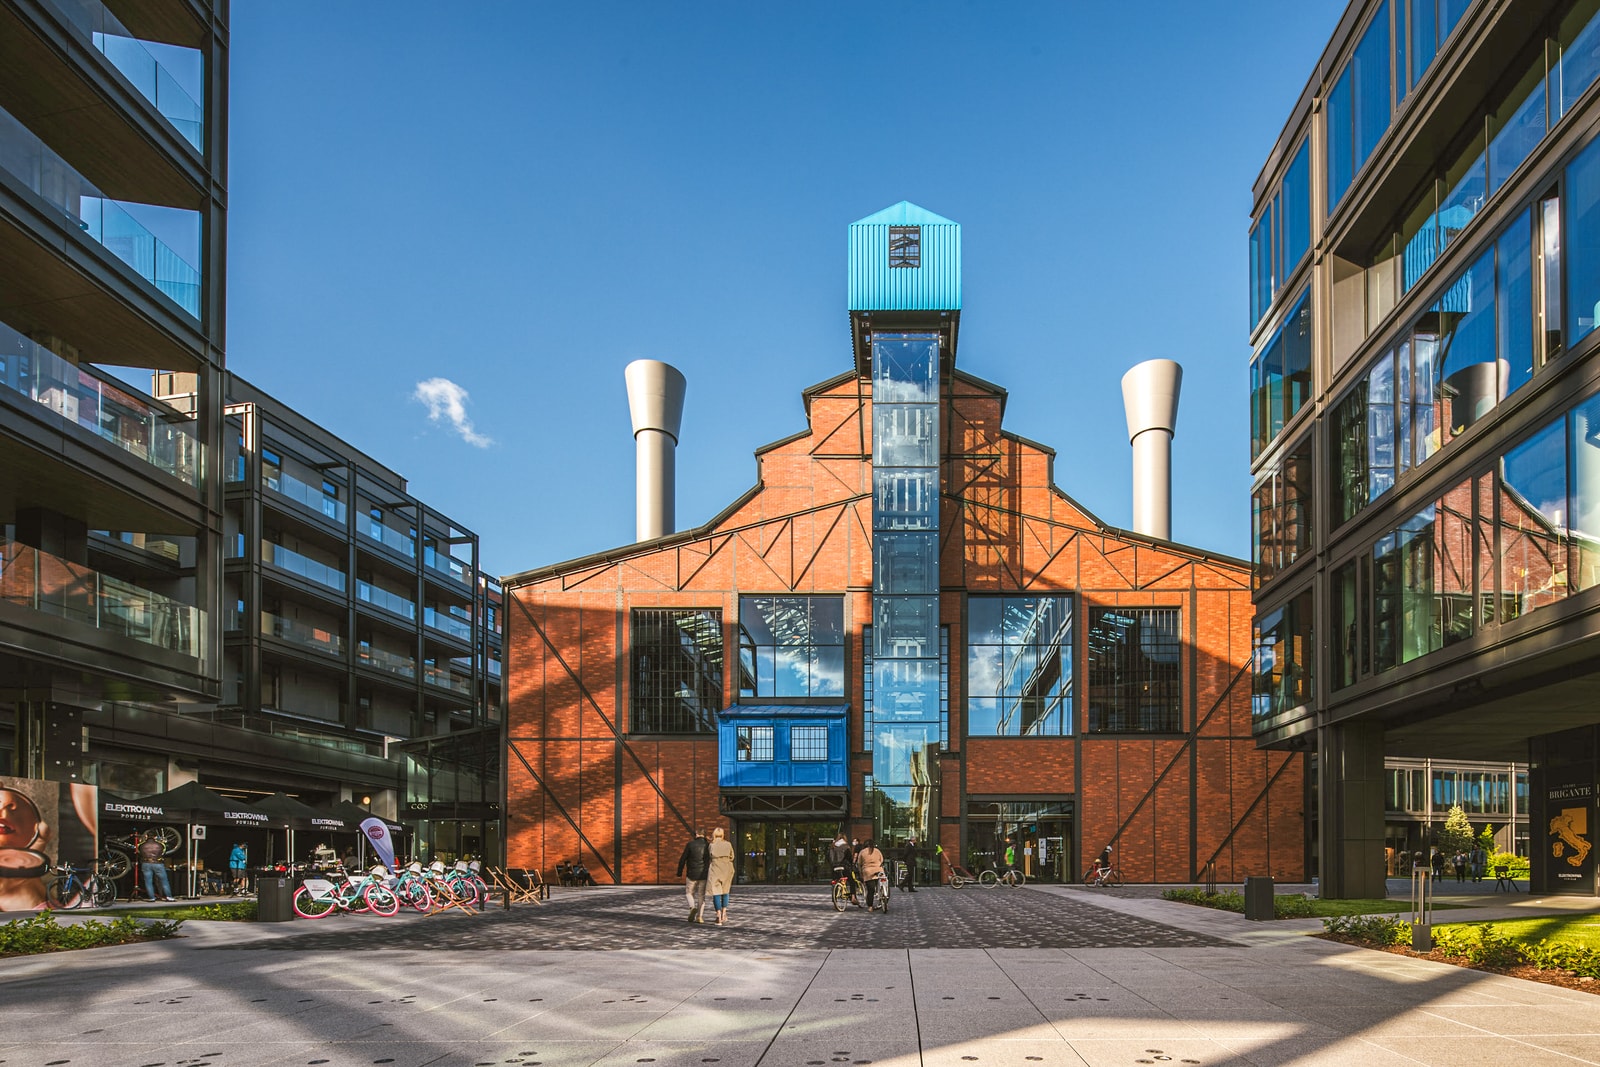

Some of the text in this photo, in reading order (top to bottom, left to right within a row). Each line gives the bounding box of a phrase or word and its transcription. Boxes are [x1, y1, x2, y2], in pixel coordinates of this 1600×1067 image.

[1549, 786, 1591, 799] BRIGANTE
[105, 803, 163, 814] ELEKTROWNIA
[224, 812, 268, 821] ELEKTROWNIA
